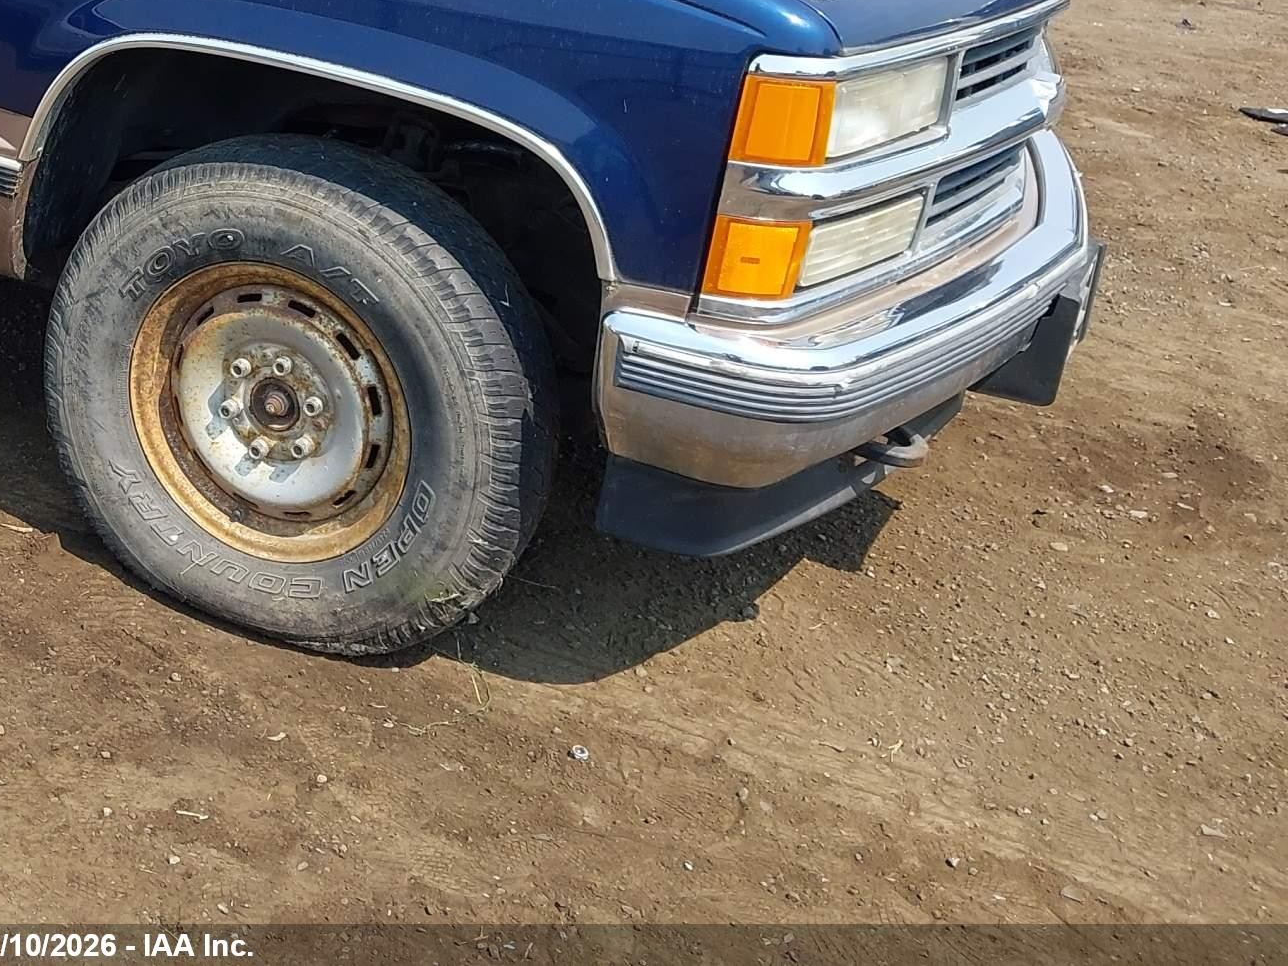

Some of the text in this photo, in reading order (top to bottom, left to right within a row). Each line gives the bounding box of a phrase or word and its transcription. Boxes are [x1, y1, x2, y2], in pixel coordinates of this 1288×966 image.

[119, 228, 380, 306] TOYO A/T
[108, 460, 437, 600] OPEN COUNTRY
